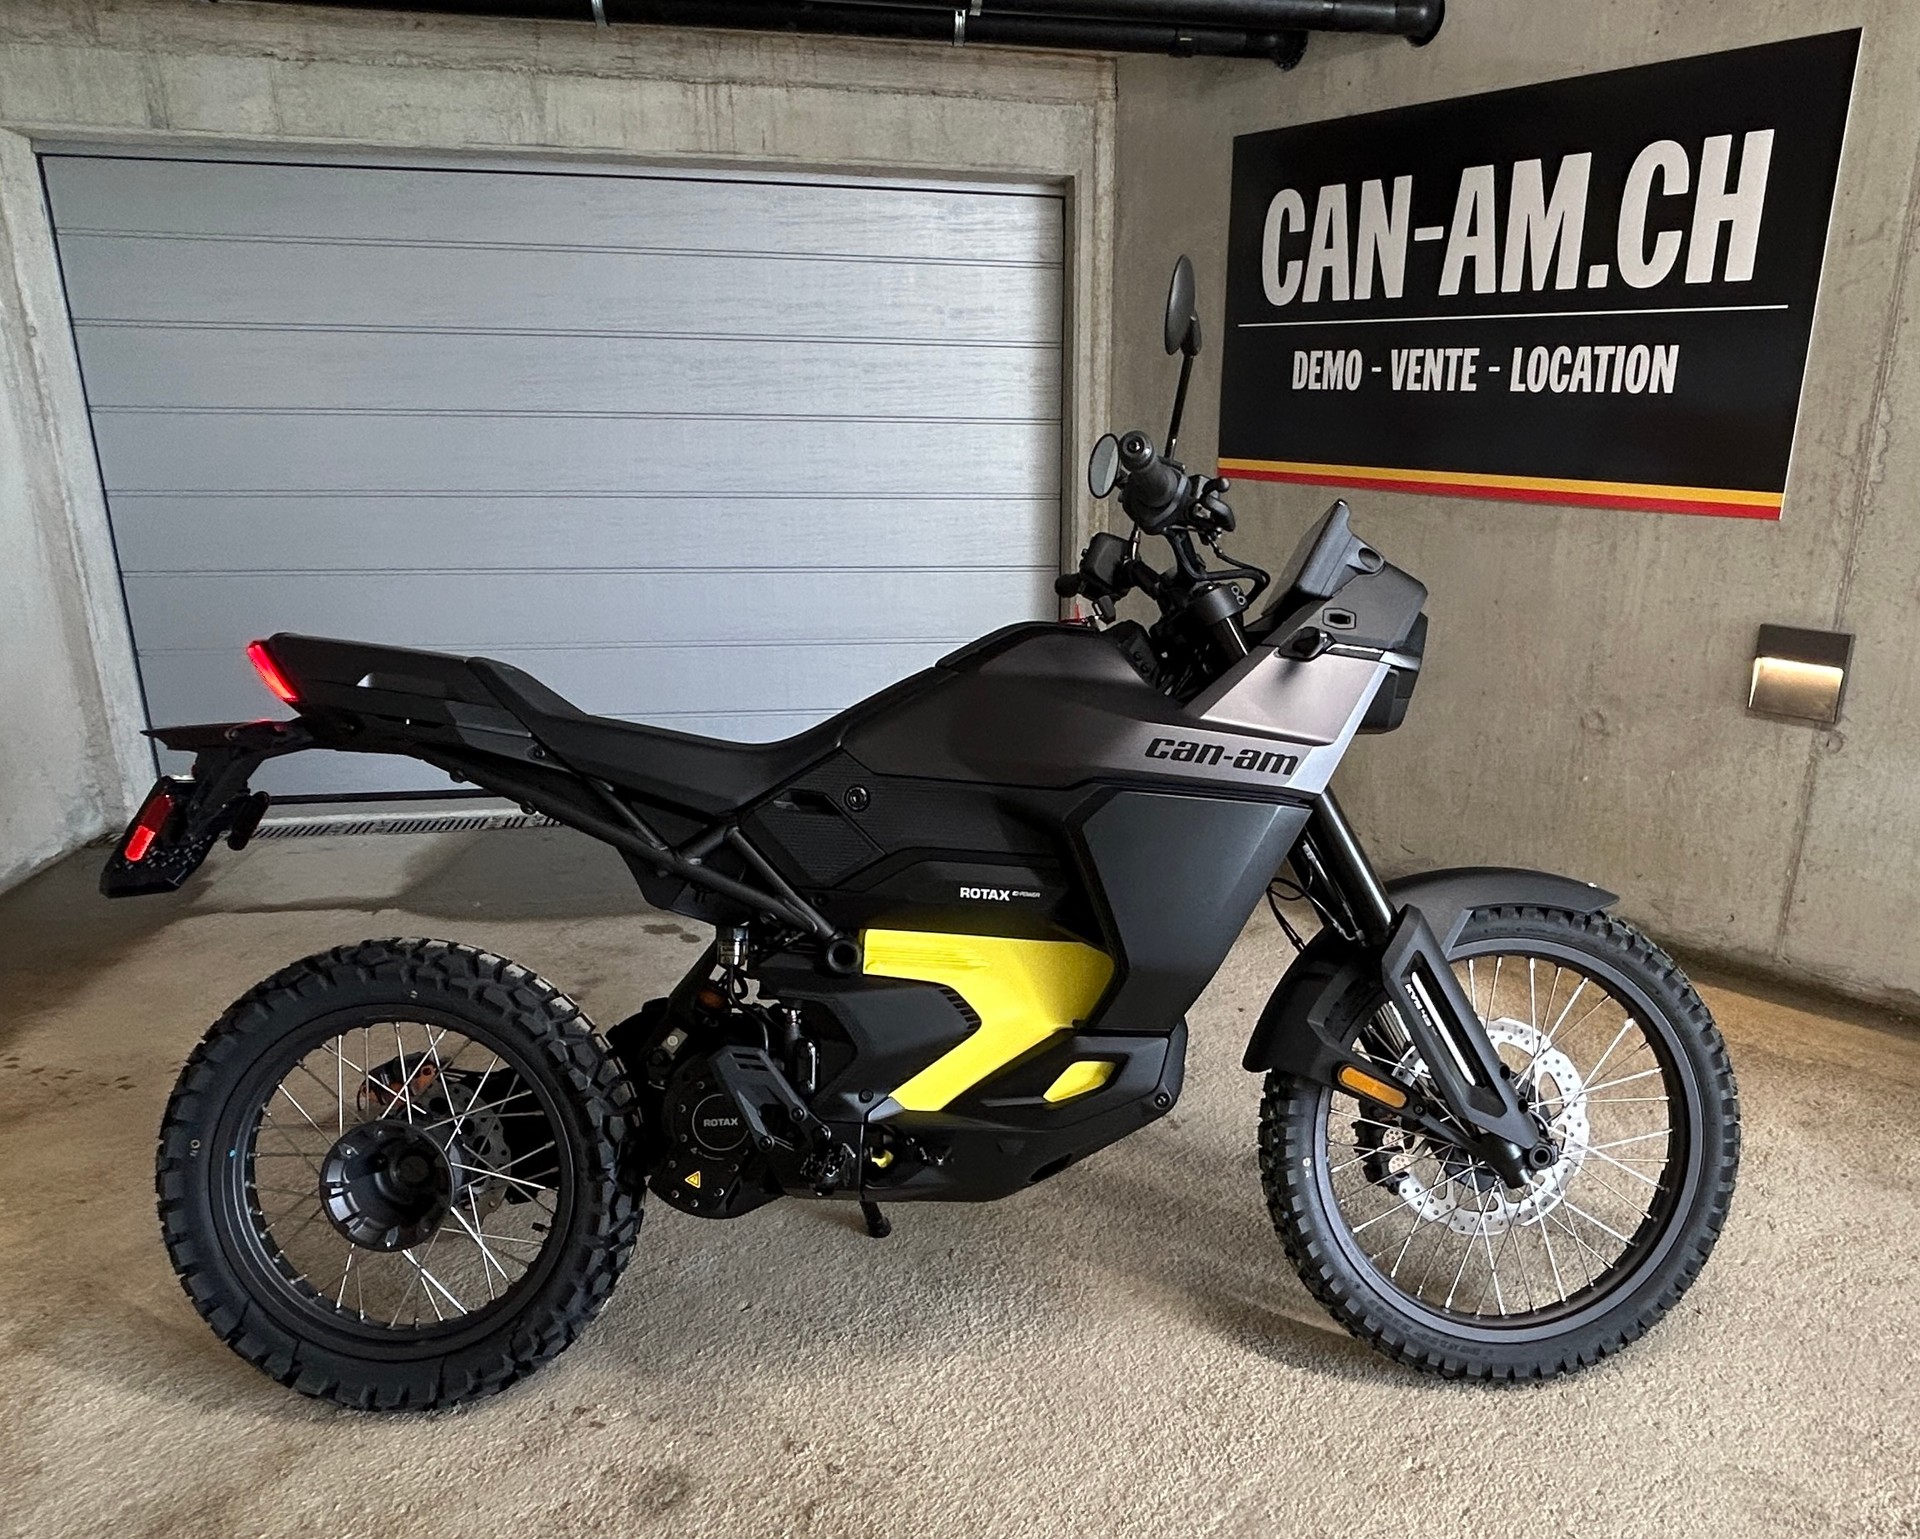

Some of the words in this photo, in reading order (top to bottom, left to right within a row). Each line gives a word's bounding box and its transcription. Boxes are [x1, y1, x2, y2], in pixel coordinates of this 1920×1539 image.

[1262, 129, 1775, 307] CAN-AM.CH
[1292, 348, 1363, 391] DEMO
[1390, 347, 1481, 392] VENTE
[1509, 344, 1680, 394] LOCATION
[1144, 738, 1299, 776] can-am
[960, 887, 1010, 901] ROTAX
[703, 1117, 739, 1127] ROTAX
